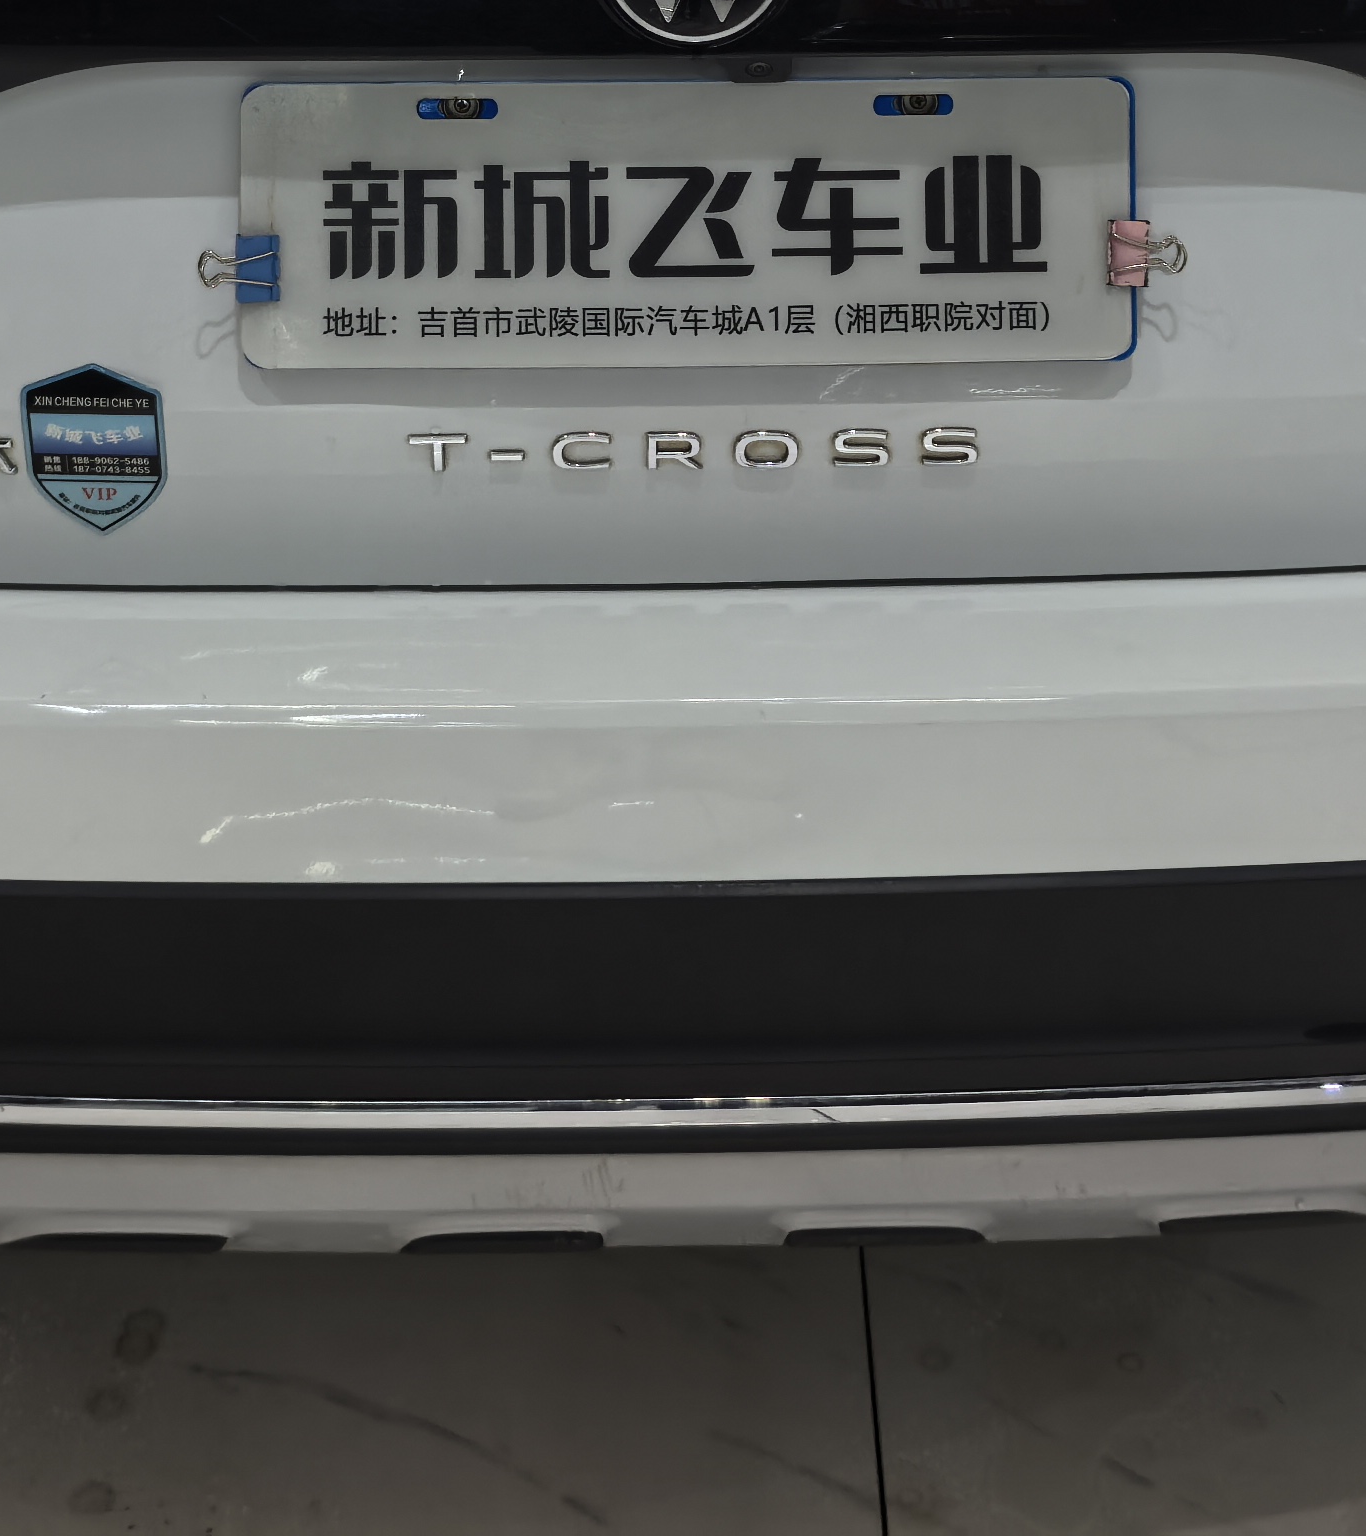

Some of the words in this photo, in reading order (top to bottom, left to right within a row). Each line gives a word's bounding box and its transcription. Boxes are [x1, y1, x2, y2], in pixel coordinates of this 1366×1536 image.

[321, 154, 1048, 279] 新城飞车业
[34, 395, 53, 406] XIN
[54, 396, 92, 407] CHENG
[93, 397, 110, 407] FEI
[111, 398, 134, 408] CHE
[135, 398, 150, 408] YE
[44, 424, 144, 445] 新城飞车业
[408, 427, 980, 472] T-CROSS
[82, 487, 117, 501] VIP
